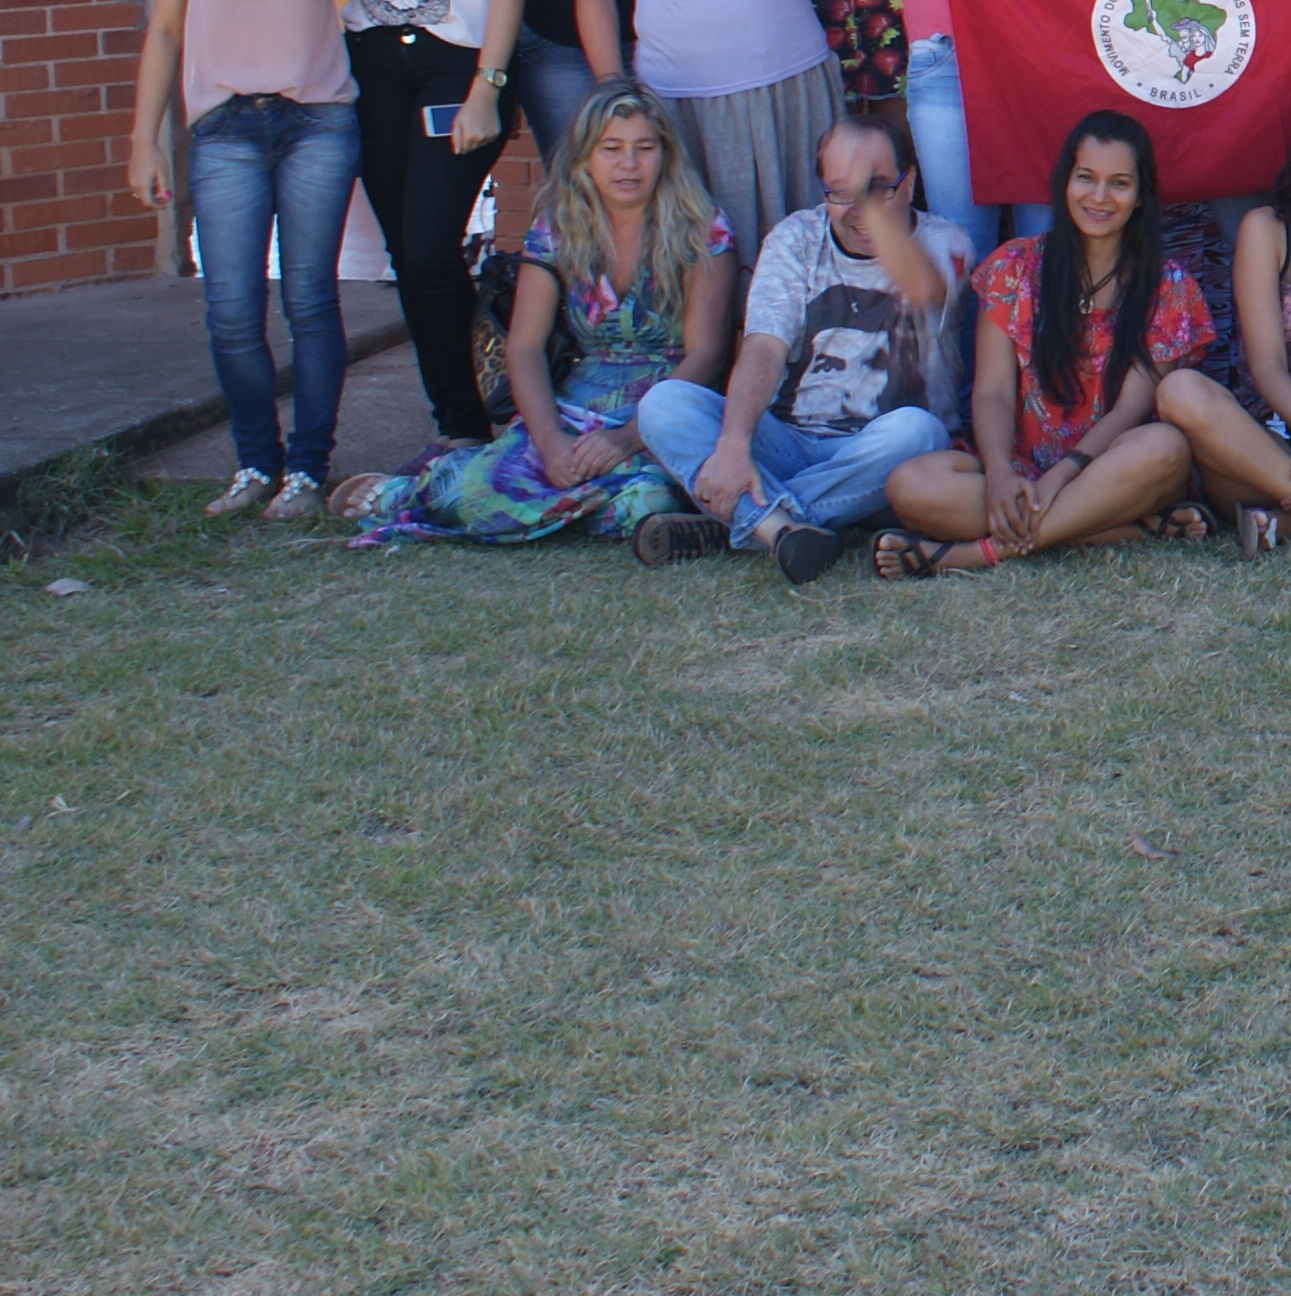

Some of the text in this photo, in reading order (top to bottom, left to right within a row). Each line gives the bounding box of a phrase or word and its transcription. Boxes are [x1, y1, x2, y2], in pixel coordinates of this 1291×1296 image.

[1237, 13, 1251, 38] SEM
[1099, 14, 1130, 78] MOVIMENTO
[1223, 41, 1250, 76] TERRA
[1149, 87, 1203, 102] BRASIL
